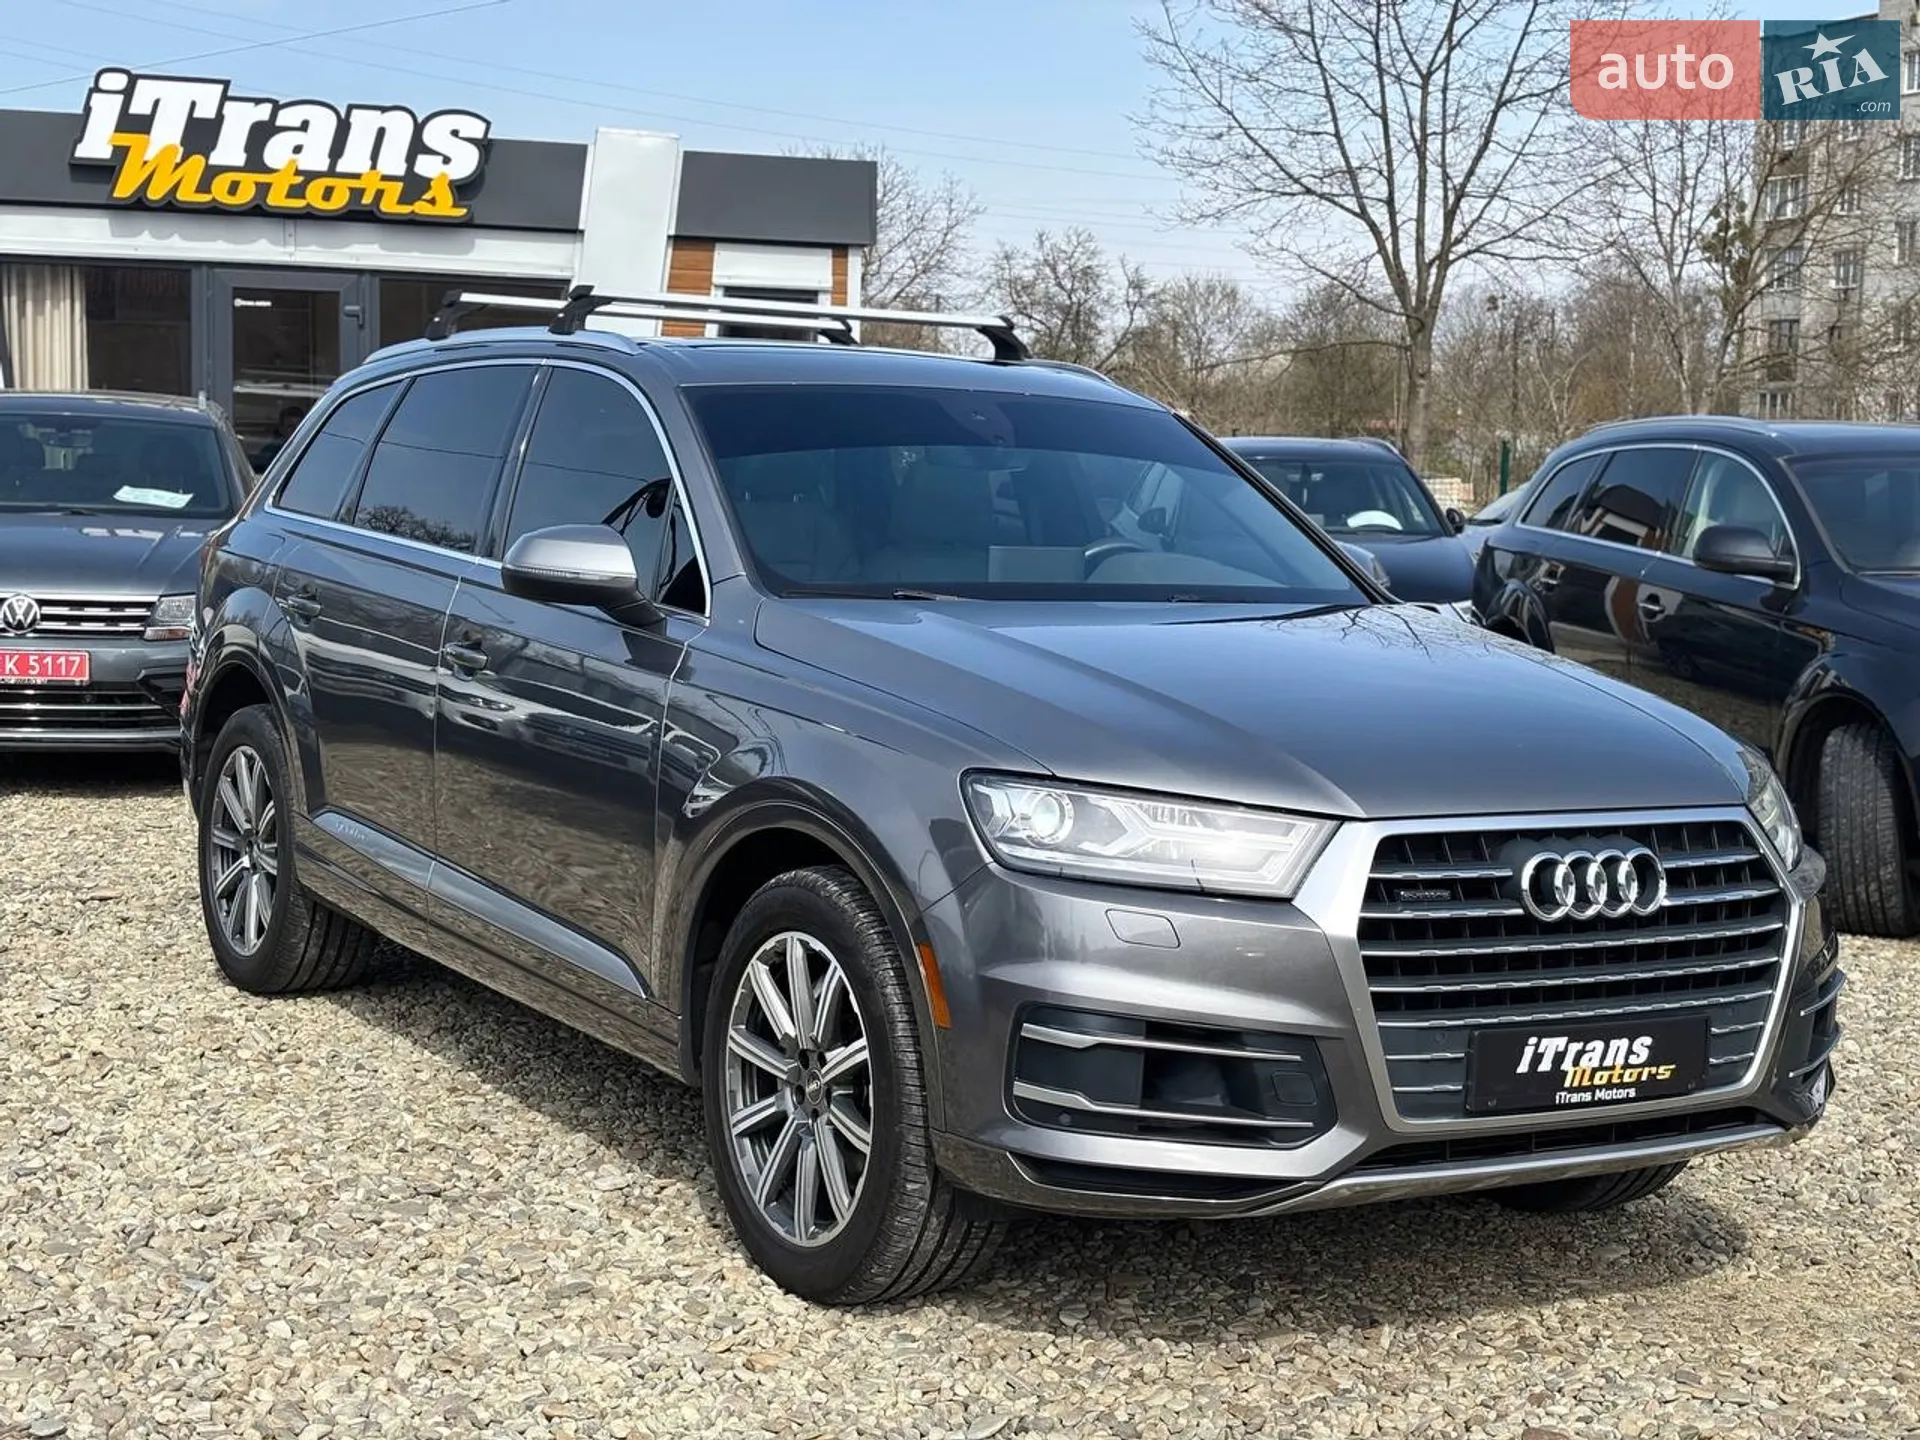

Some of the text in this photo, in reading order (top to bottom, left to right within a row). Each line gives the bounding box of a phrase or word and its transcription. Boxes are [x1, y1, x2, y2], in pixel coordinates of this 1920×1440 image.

[74, 72, 488, 181] iTrans
[107, 132, 469, 217] Motors
[28, 655, 81, 676] 5117
[1516, 1036, 1653, 1074] iTrans
[1563, 1063, 1677, 1088] Motors
[1555, 1087, 1636, 1105] iTrans Motors
